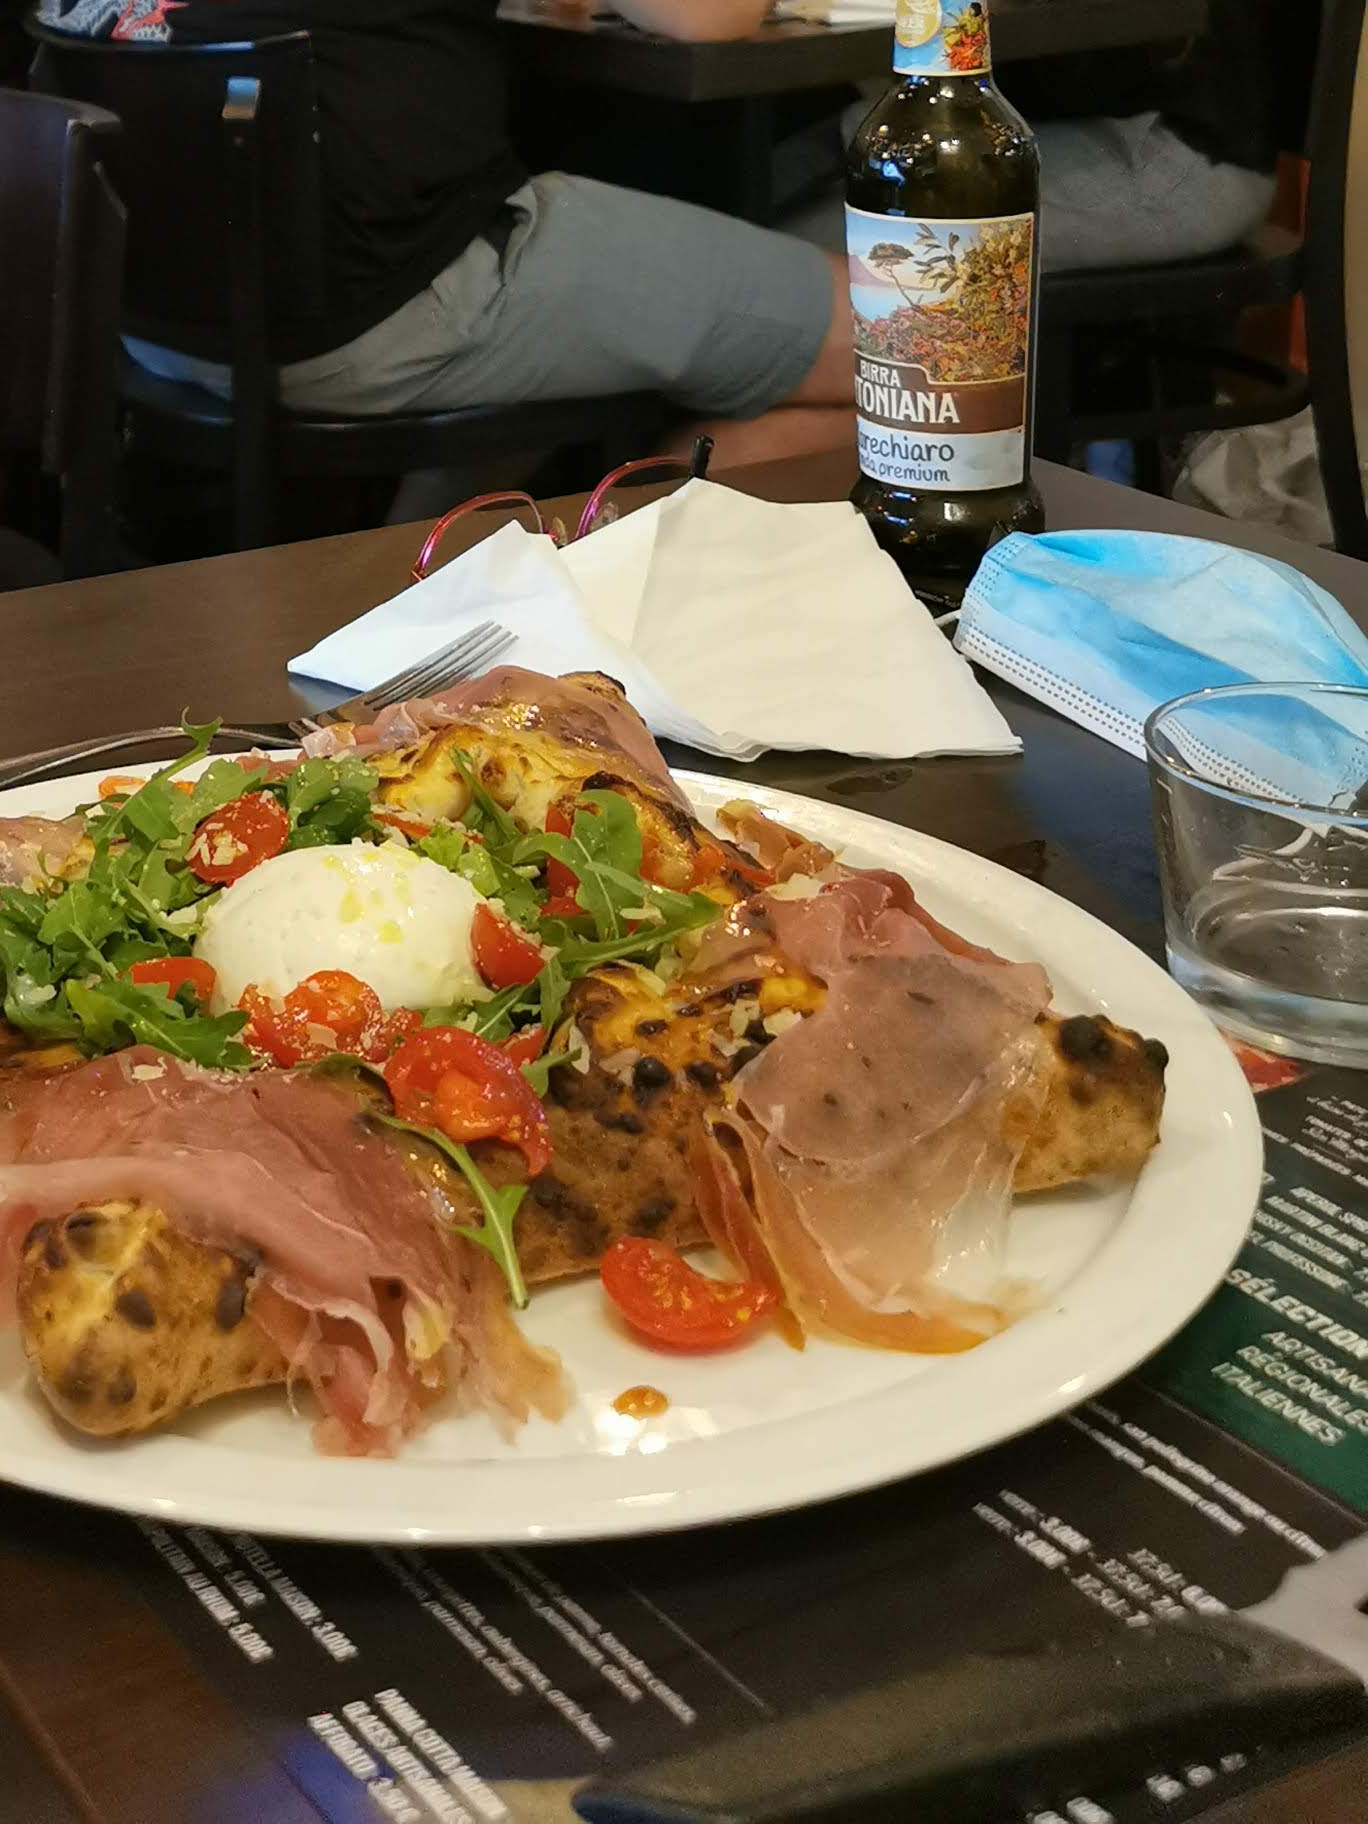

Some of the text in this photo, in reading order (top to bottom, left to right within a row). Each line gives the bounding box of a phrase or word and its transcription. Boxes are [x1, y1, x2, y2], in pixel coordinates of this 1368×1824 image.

[860, 359, 901, 388] BIRRA
[855, 376, 961, 424] TONIANA
[860, 432, 955, 462] arechiaro
[878, 461, 950, 482] premium
[1261, 1331, 1368, 1399] ARTISAN
[1210, 1362, 1346, 1446] ITALIENNES
